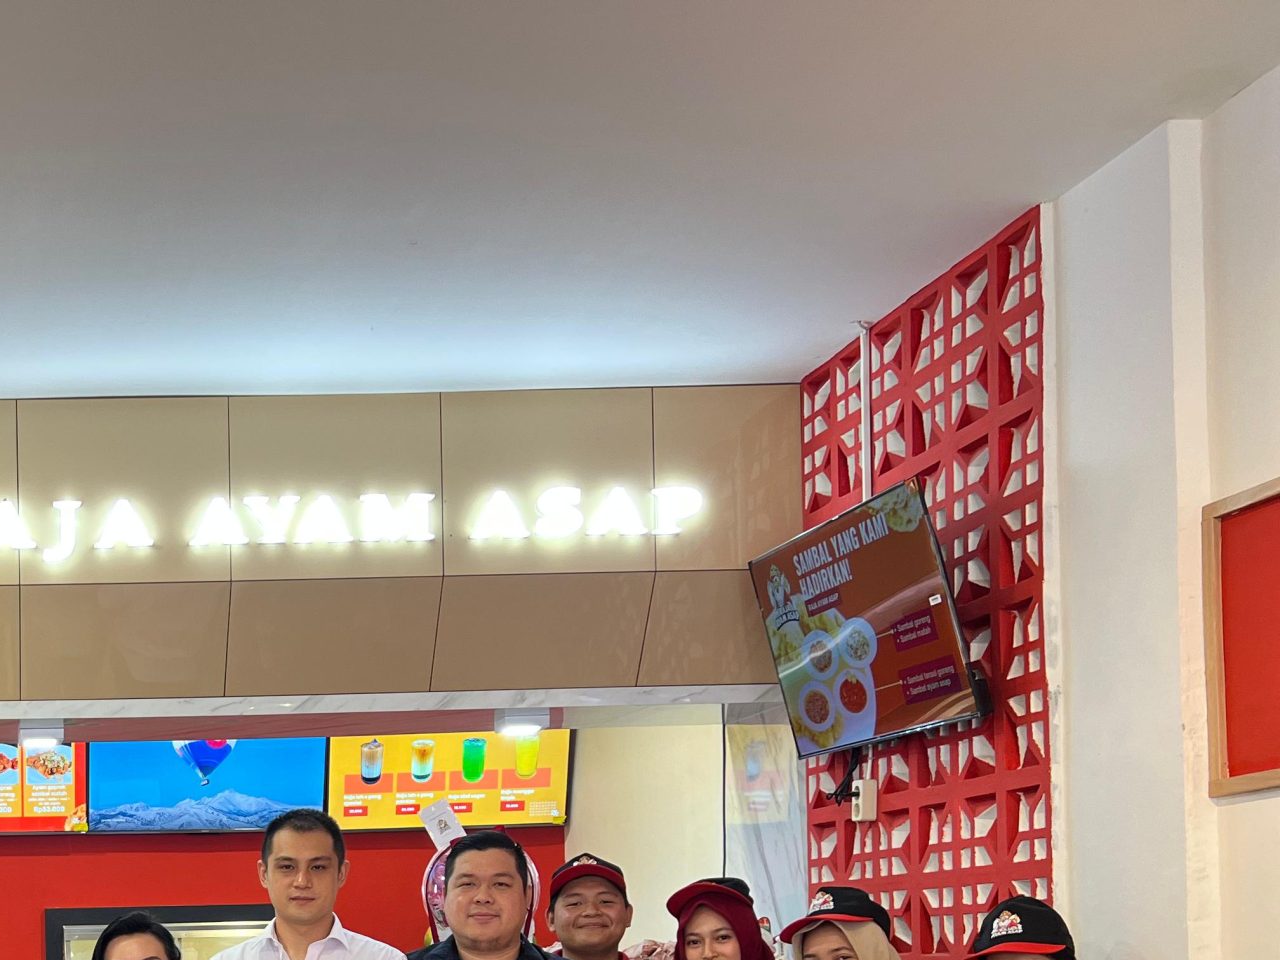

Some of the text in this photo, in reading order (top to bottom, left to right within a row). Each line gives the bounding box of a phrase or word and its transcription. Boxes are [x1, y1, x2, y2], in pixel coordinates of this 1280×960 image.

[188, 493, 436, 546] AYAM
[468, 486, 703, 540] ASAP
[793, 511, 889, 576] SAMBAL YANG KAMI
[799, 558, 853, 599] HADIRKAN!
